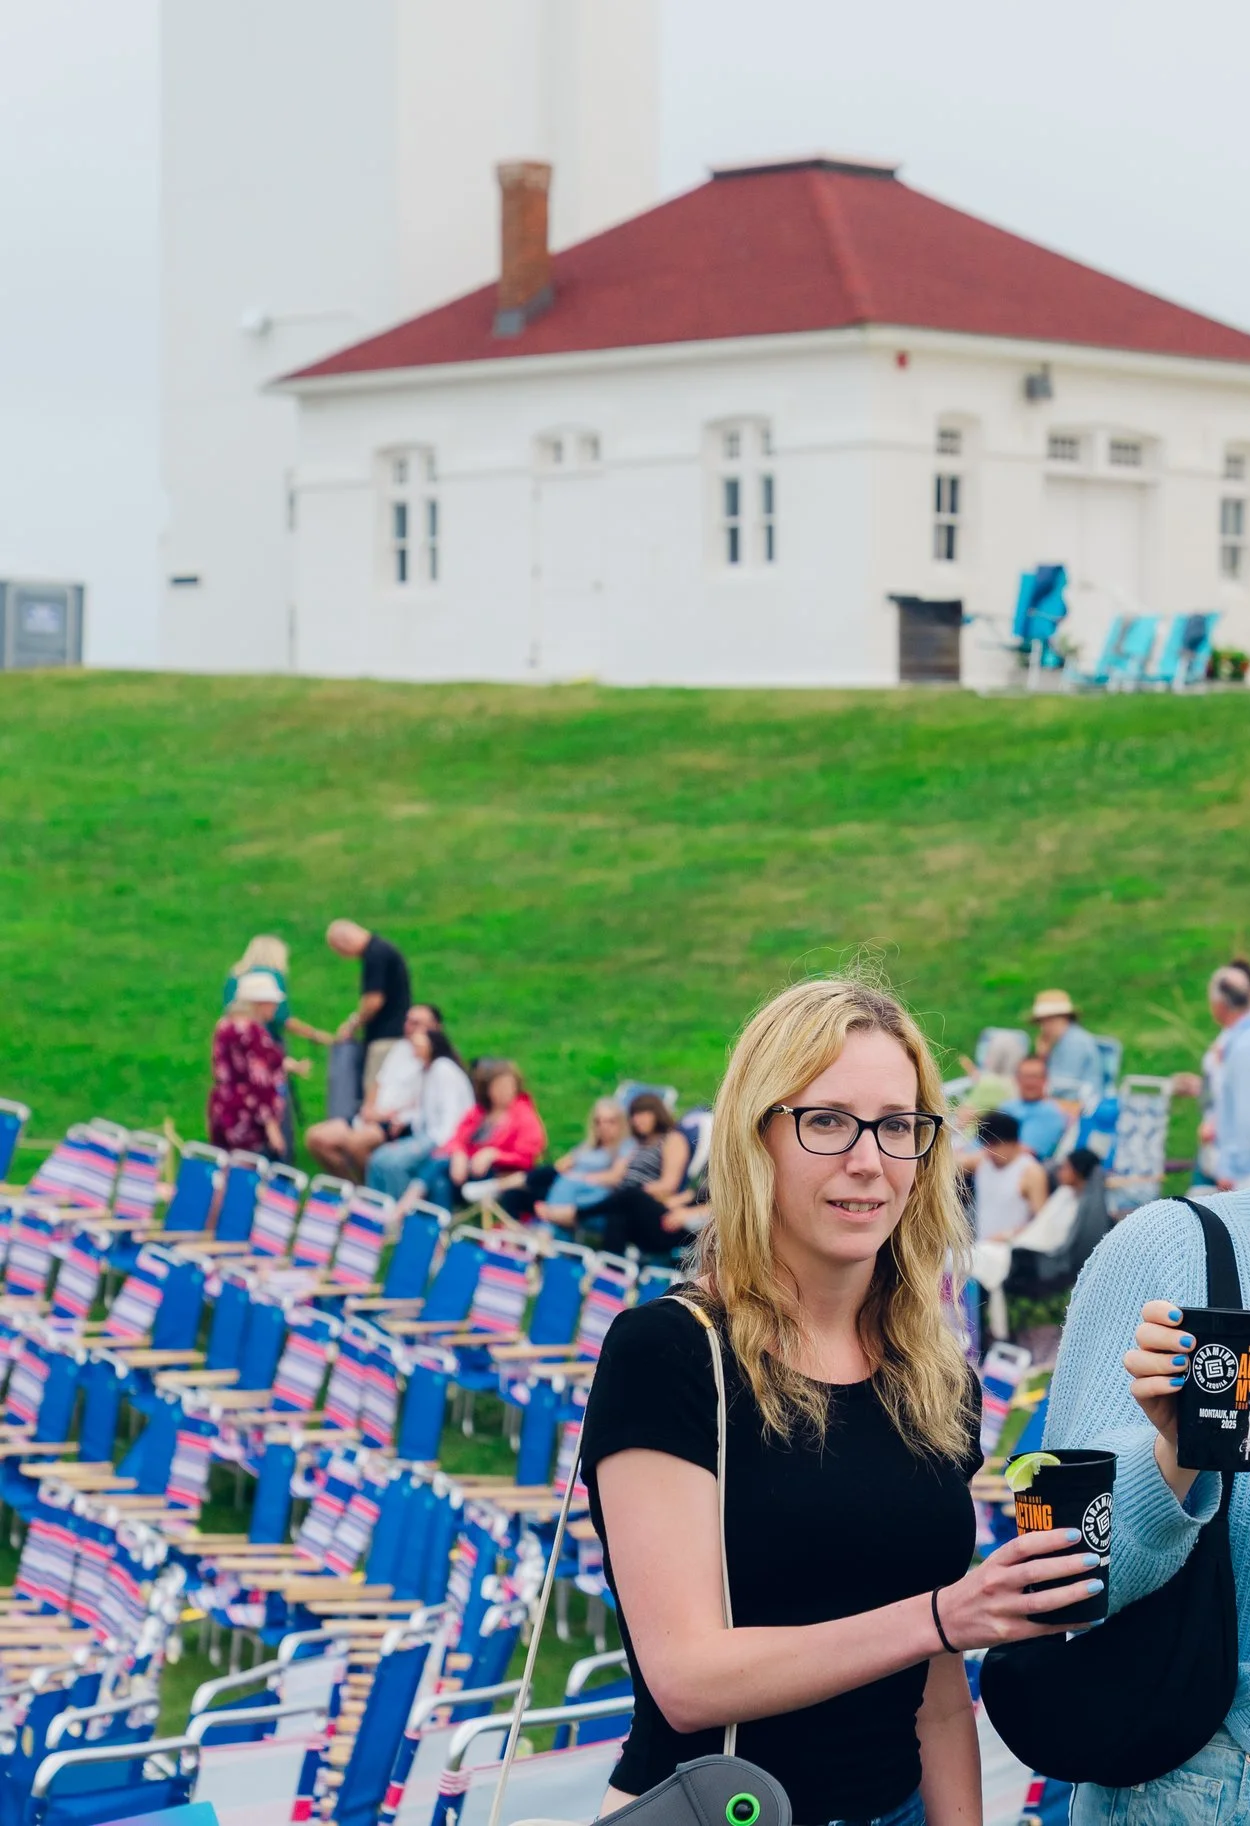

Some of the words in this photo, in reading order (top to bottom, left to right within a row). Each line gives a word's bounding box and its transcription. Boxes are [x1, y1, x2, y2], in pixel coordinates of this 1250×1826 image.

[1194, 1347, 1235, 1370] CORAMINO
[1205, 1379, 1228, 1390] TEQUILA
[1199, 1408, 1228, 1419] MONTAUK,
[1229, 1410, 1238, 1420] NY
[1221, 1419, 1237, 1429] 2025
